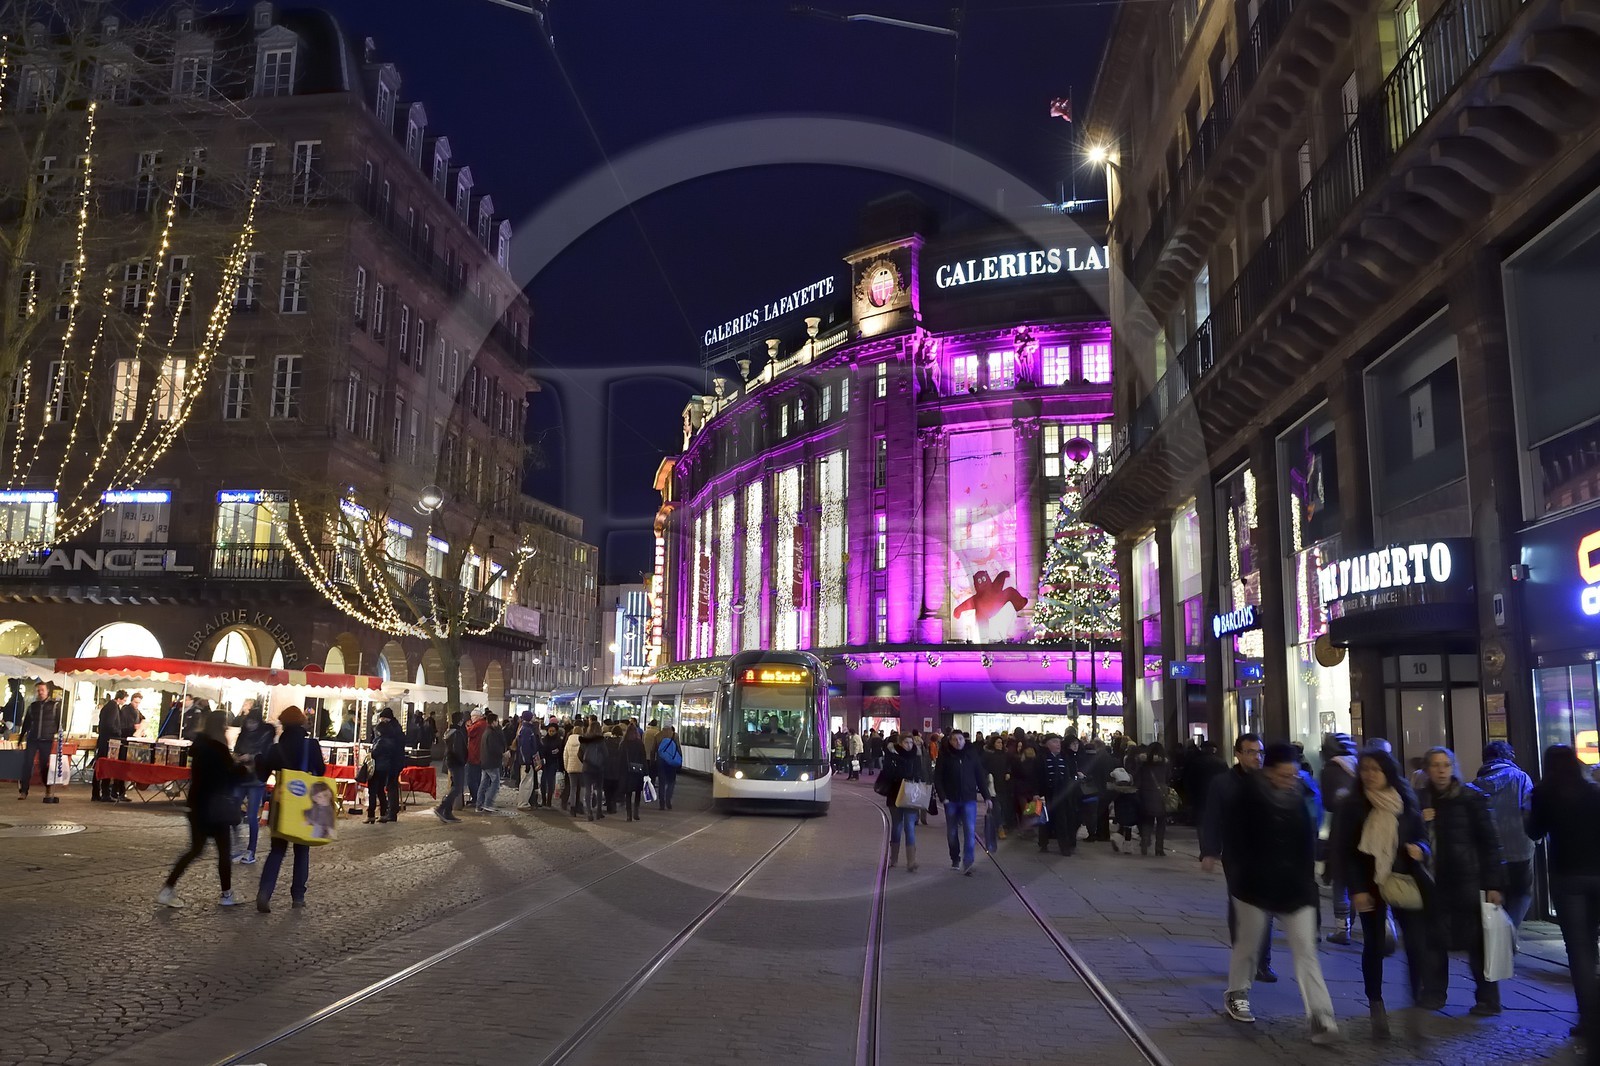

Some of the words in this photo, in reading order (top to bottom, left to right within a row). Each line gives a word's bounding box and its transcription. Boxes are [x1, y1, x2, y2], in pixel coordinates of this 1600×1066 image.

[936, 248, 1062, 289] GALERIES
[704, 309, 759, 347] GALERIES
[764, 275, 834, 322] LAFAYETTE
[17, 548, 194, 572] LANCEL
[1220, 605, 1254, 633] BARCLAYS
[1413, 662, 1427, 674] 10
[1006, 690, 1073, 705] GALERIE
